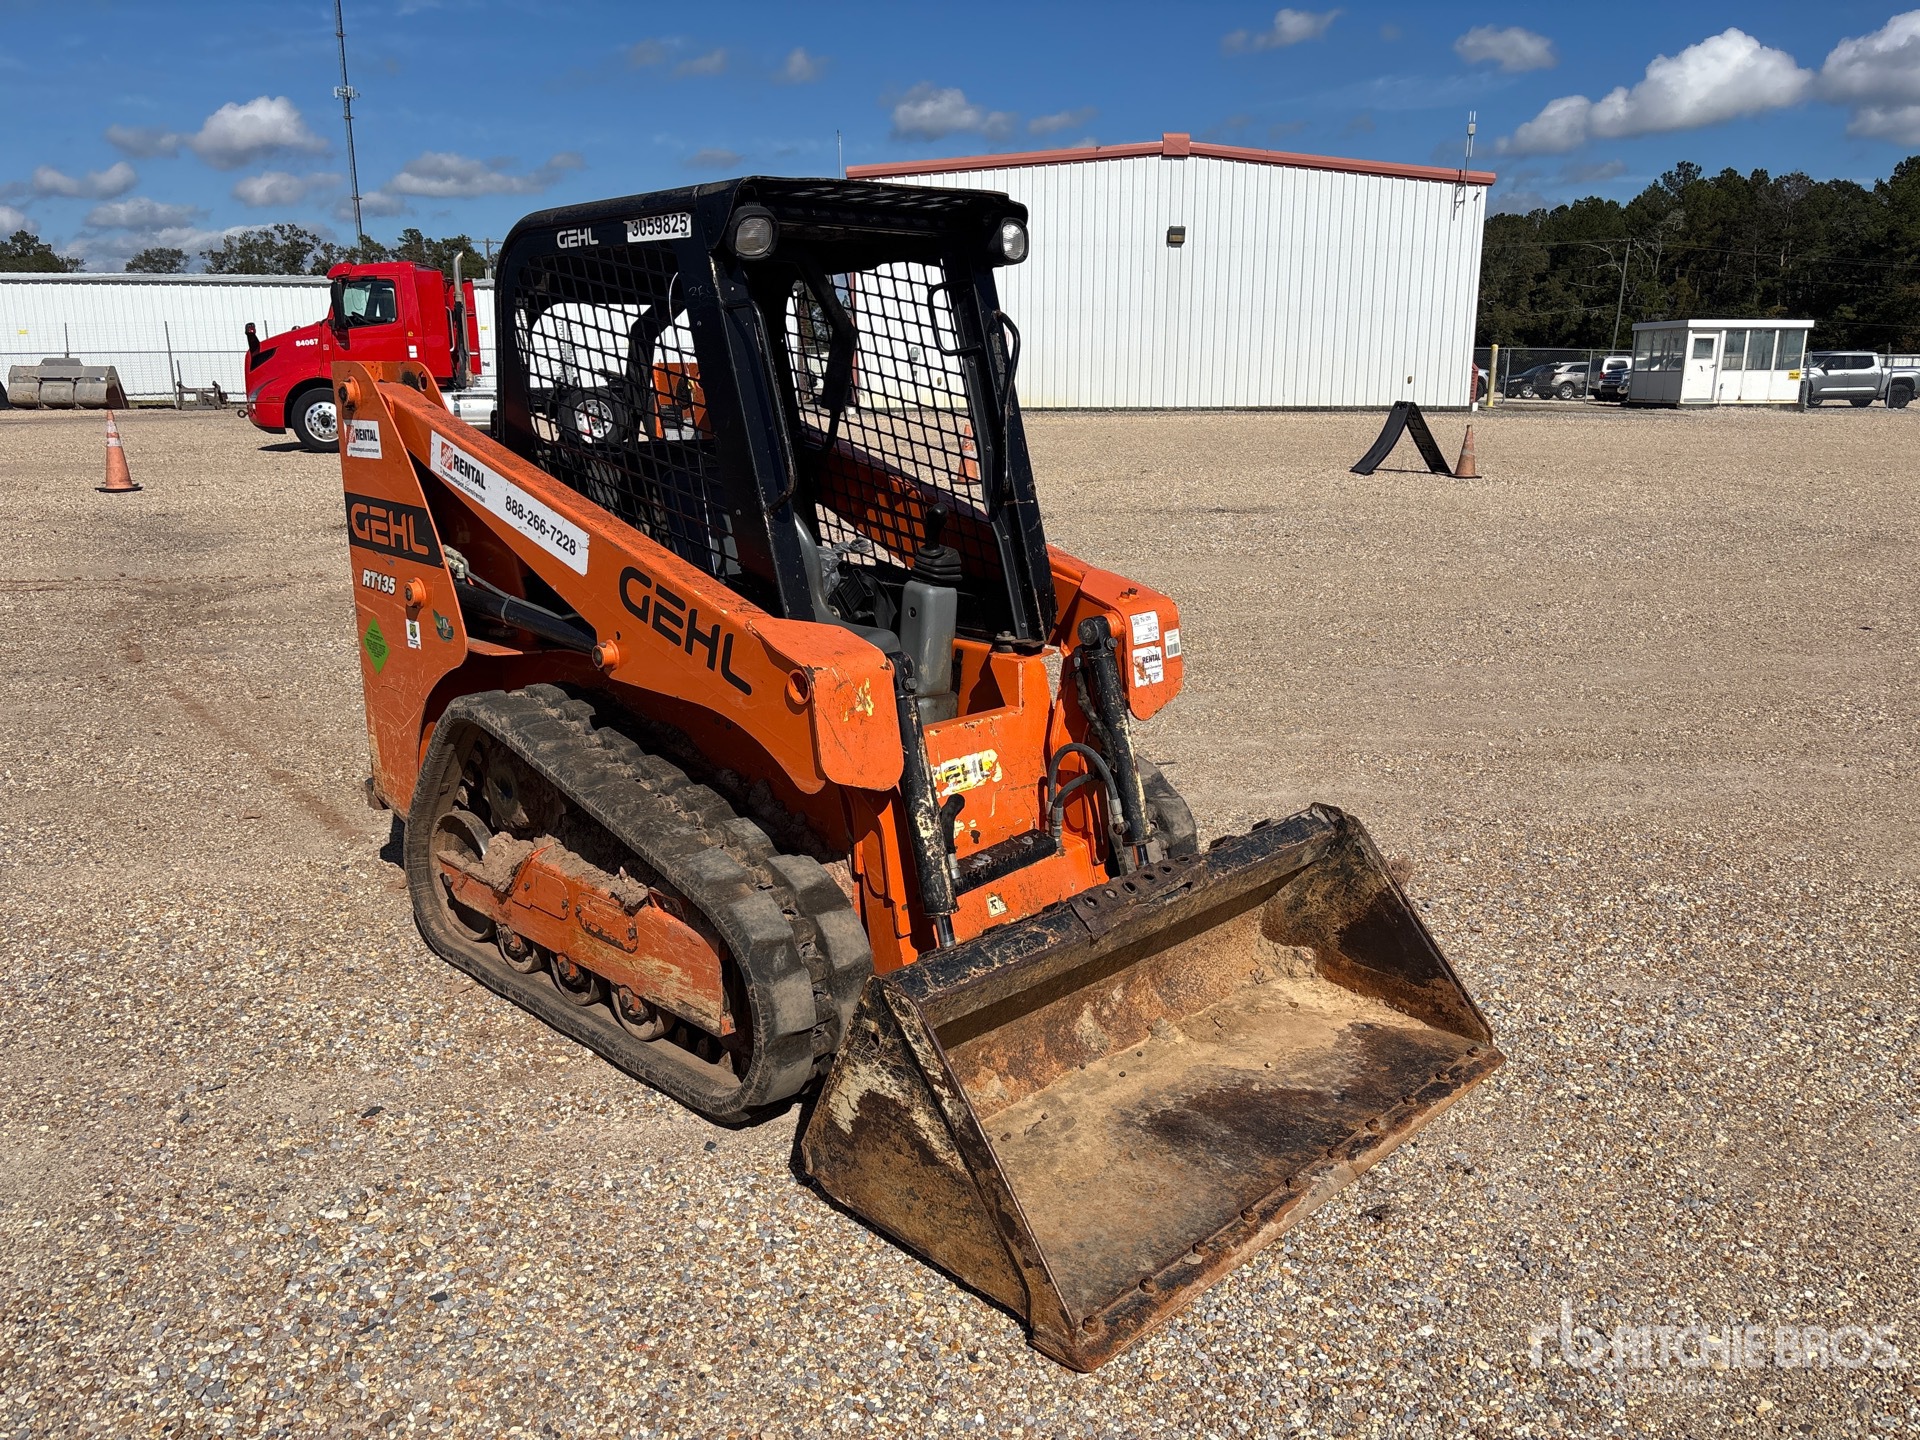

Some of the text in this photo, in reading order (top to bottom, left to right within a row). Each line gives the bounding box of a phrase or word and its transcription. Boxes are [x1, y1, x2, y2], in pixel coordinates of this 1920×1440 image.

[556, 227, 599, 249] GEHL
[630, 213, 687, 237] 3059825
[355, 428, 378, 442] RENTAL
[453, 454, 487, 490] RENTAL
[350, 502, 429, 556] GEHL
[505, 495, 577, 556] 888-266-7228
[362, 568, 396, 595] RT135
[619, 566, 752, 696] GEHL
[1142, 654, 1161, 664] RENTAL
